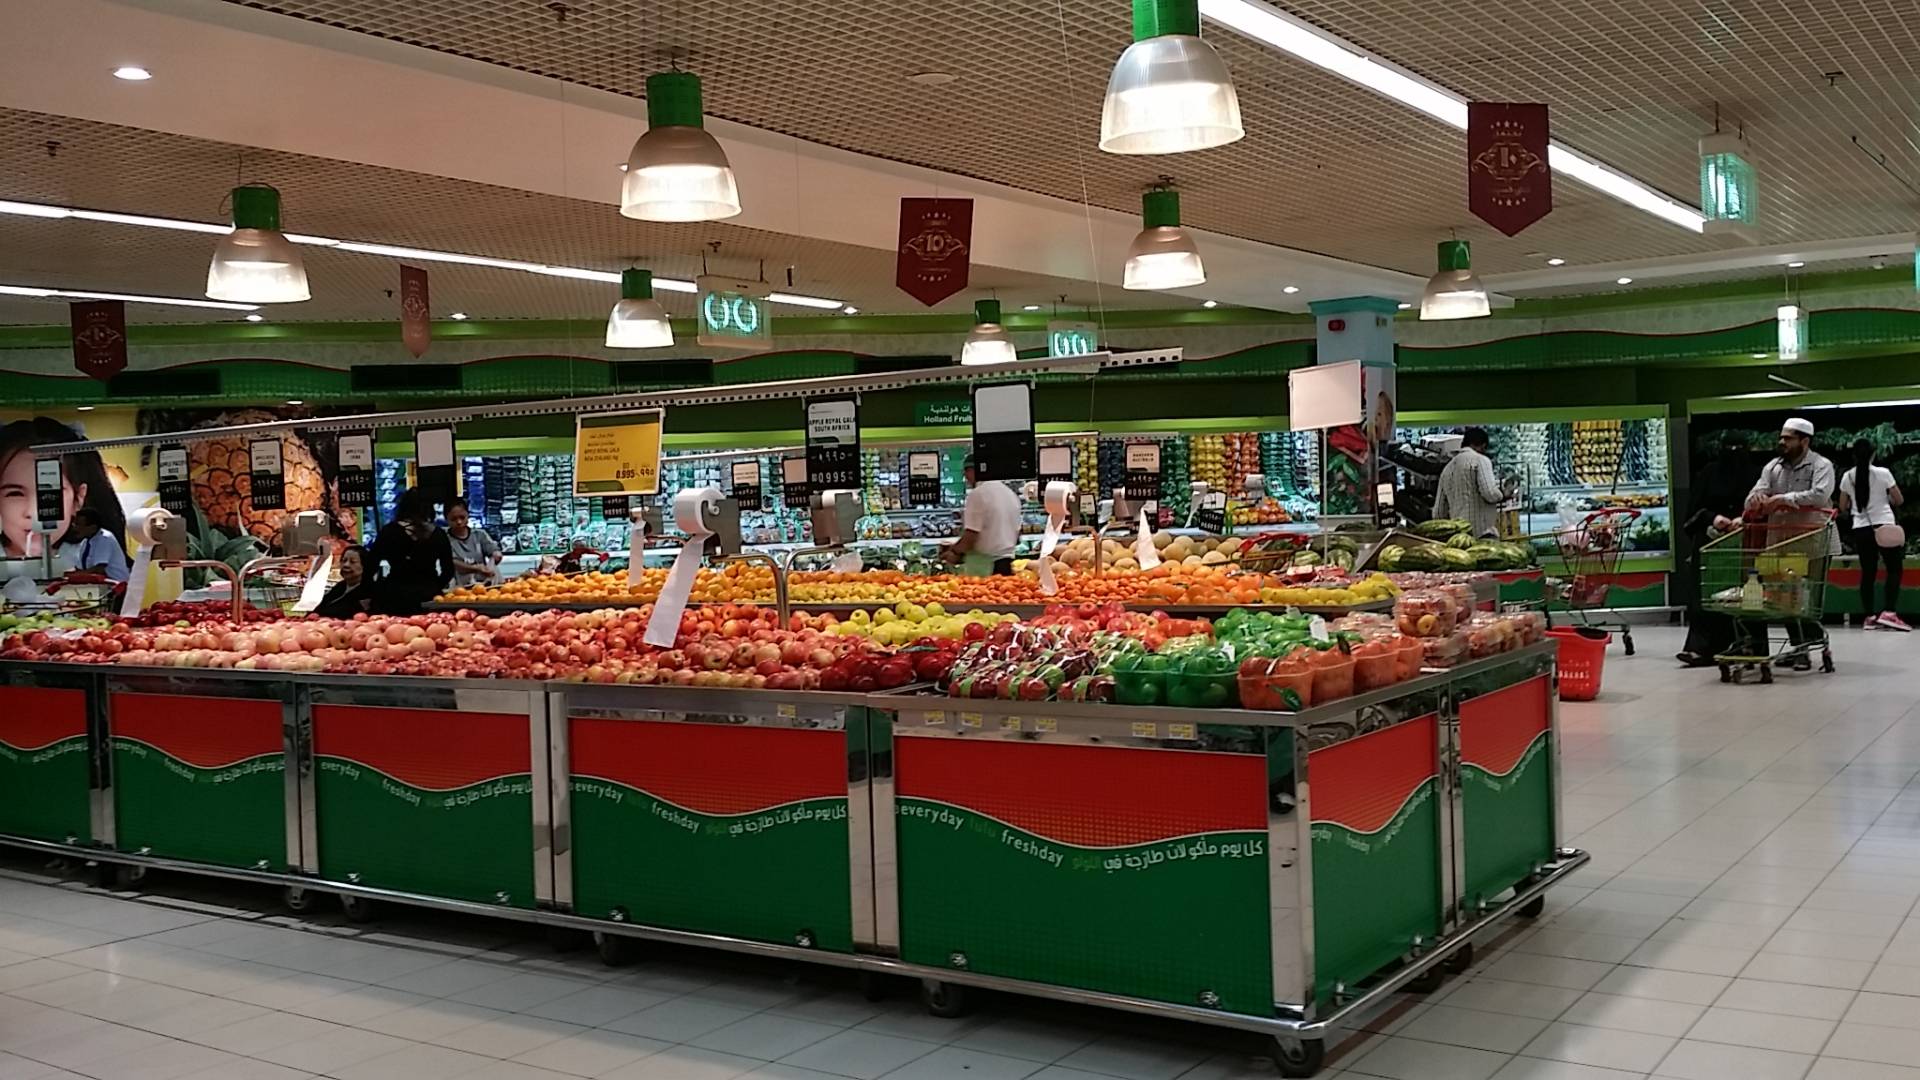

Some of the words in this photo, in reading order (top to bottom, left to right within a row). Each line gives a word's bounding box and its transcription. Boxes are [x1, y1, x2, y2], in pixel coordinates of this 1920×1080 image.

[923, 415, 953, 423] Holland
[320, 760, 361, 781] everyday
[381, 777, 422, 807] freshday
[575, 782, 624, 803] everyday
[651, 801, 701, 834] freshday
[900, 803, 964, 831] everyday
[1000, 829, 1064, 868] freshday
